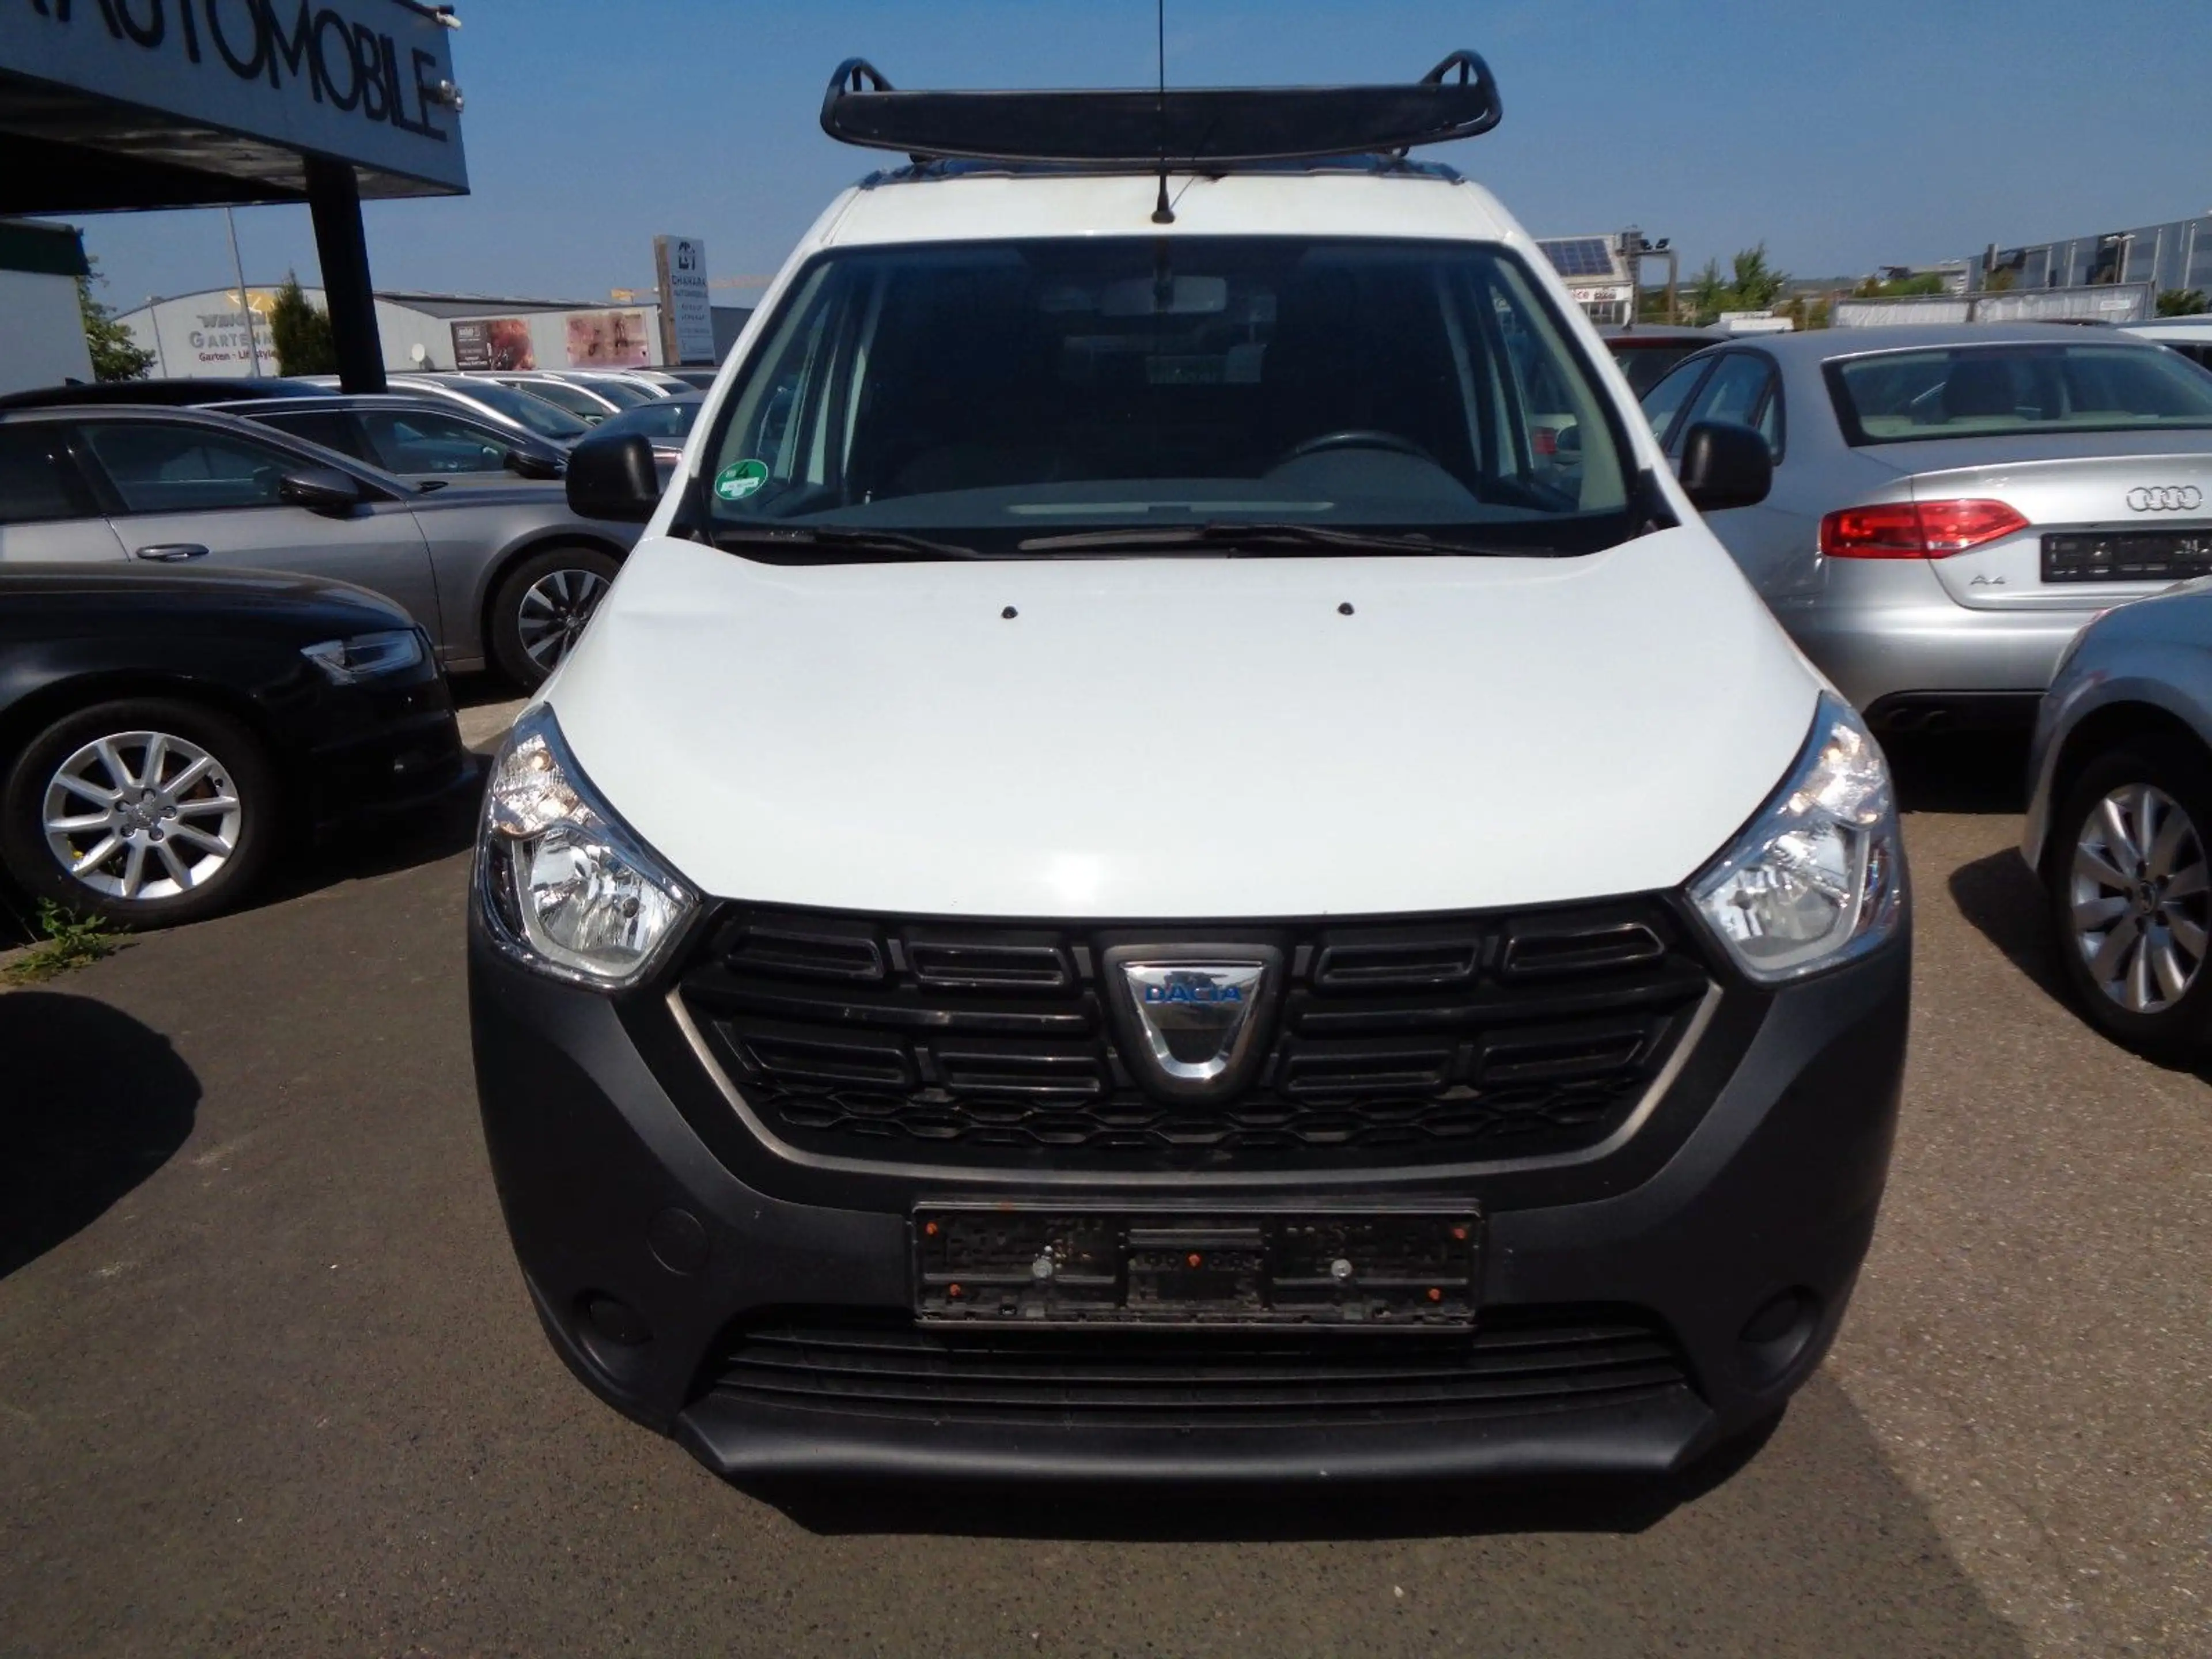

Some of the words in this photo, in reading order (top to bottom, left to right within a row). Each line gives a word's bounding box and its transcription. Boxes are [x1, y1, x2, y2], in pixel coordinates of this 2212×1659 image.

[56, 0, 447, 142] OMOBILE
[199, 351, 230, 362] Garten
[1969, 575, 2006, 585] A4
[1145, 984, 1242, 1003] DACIA
